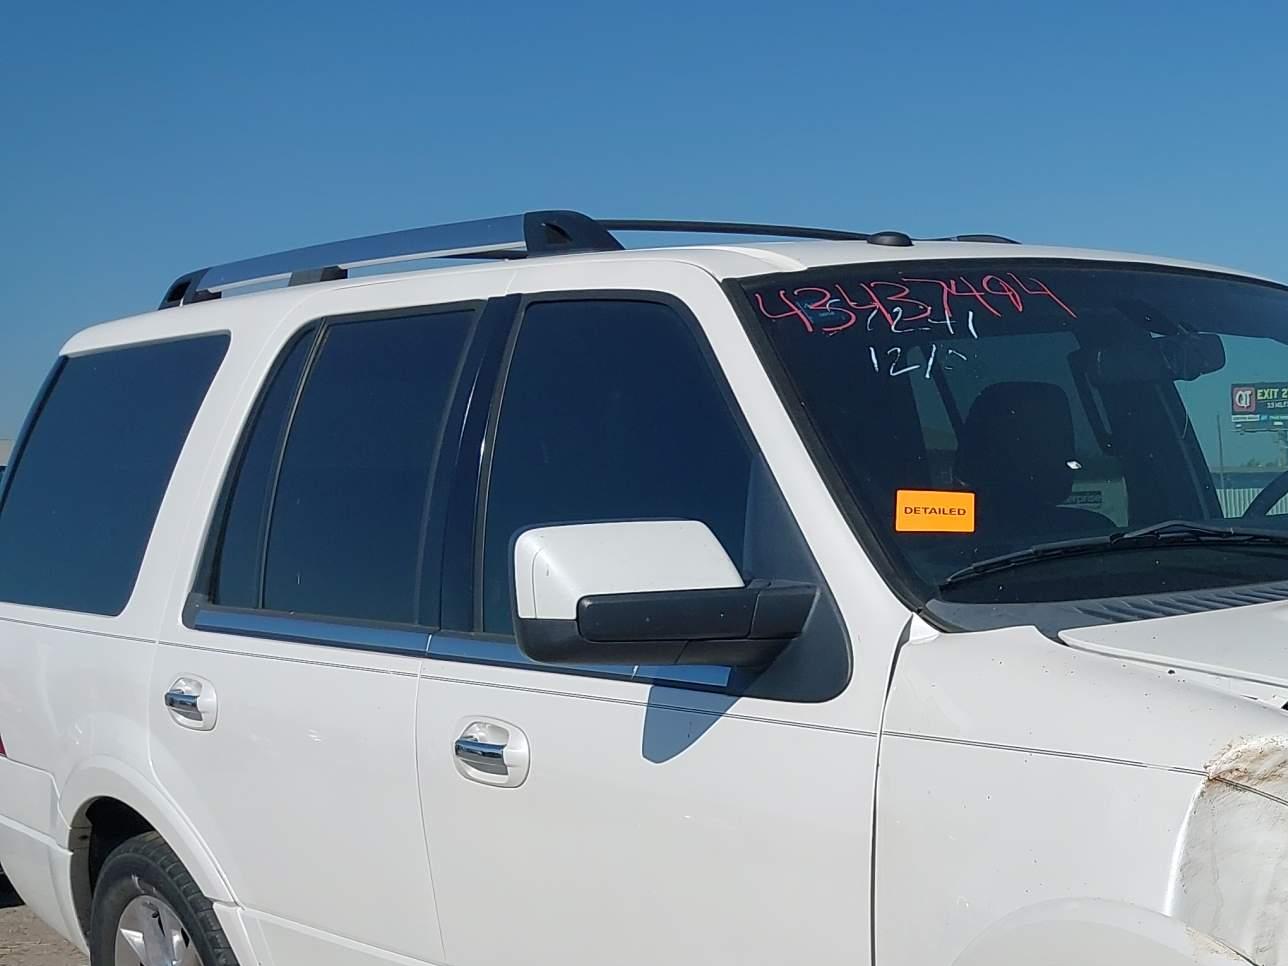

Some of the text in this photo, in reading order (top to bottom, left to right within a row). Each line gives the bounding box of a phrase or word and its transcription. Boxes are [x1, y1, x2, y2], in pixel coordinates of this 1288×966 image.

[755, 272, 1077, 332] 43437494
[1256, 388, 1279, 400] EXIT
[904, 506, 967, 516] DETAILED
